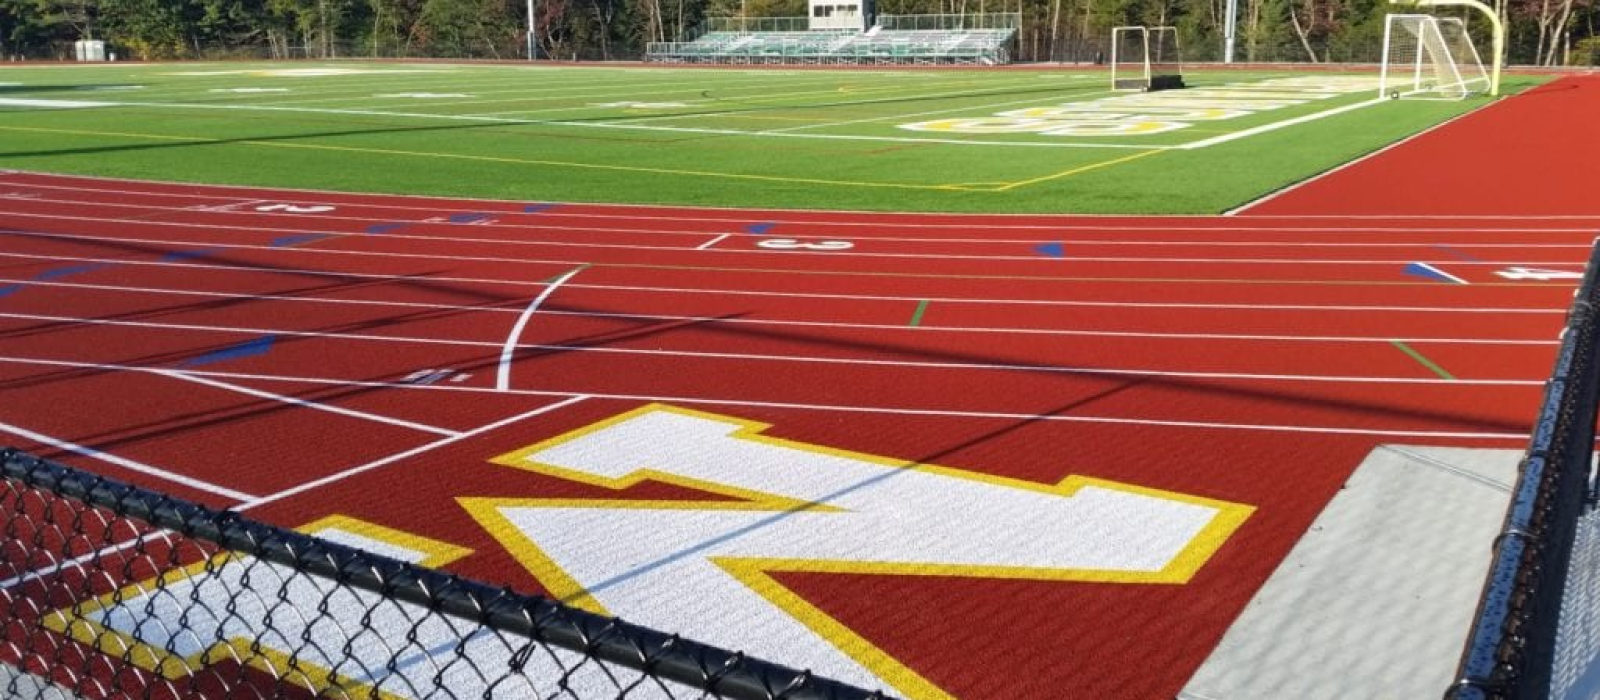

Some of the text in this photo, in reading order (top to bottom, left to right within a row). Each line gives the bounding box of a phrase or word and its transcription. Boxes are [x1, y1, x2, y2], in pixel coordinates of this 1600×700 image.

[255, 203, 336, 213] 2
[756, 238, 855, 251] 3
[1490, 265, 1585, 281] 4
